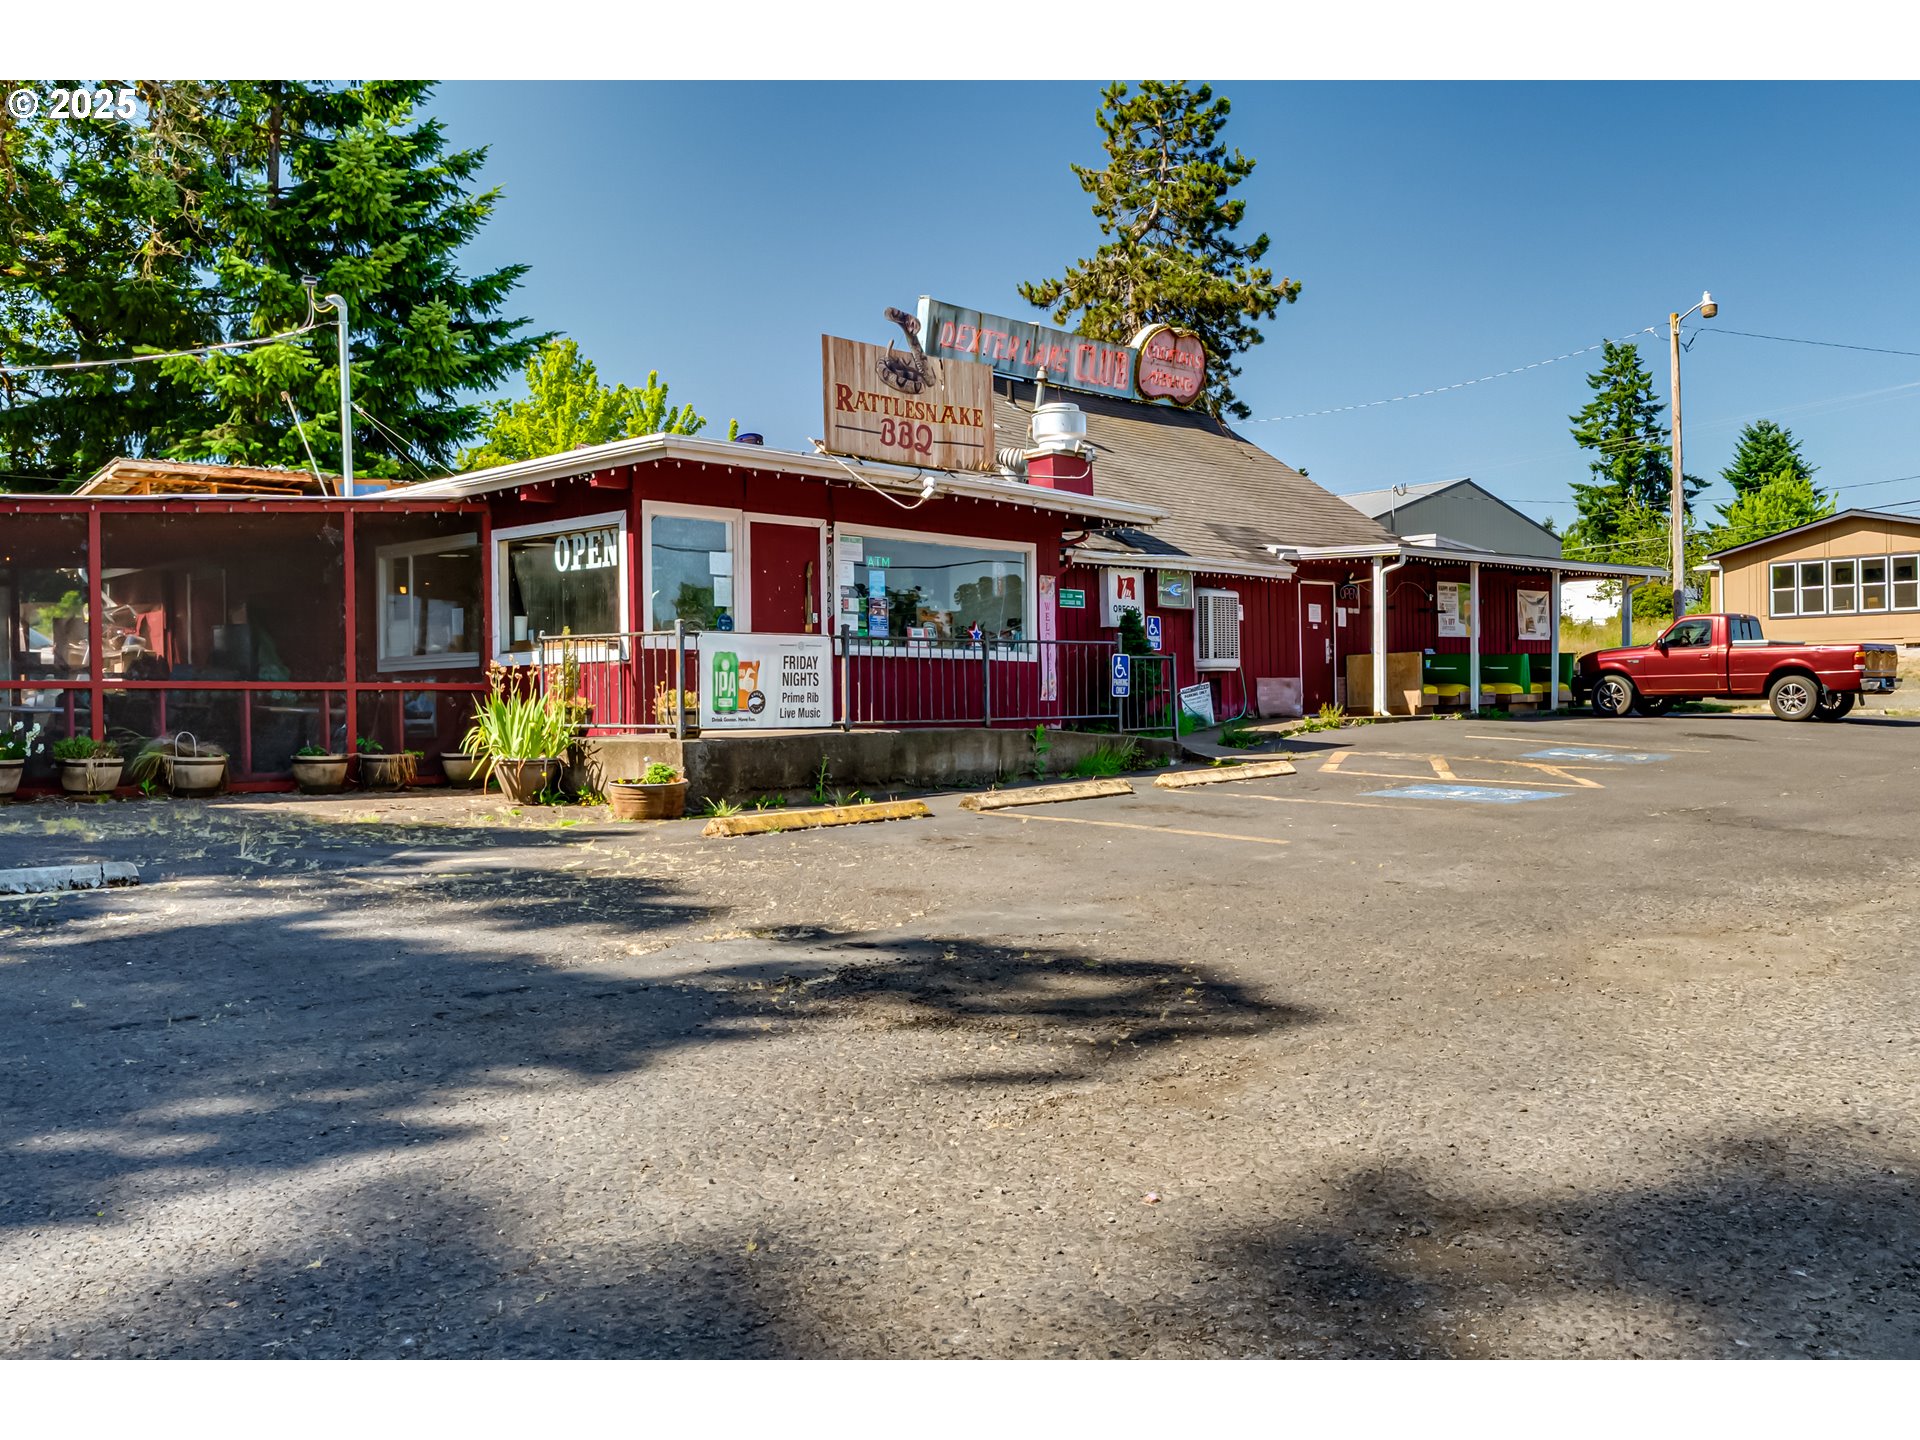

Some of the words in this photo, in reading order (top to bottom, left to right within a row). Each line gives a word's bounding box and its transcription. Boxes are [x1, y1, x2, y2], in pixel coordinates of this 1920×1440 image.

[939, 321, 1020, 362] DEXTER
[1022, 338, 1070, 372] LAKE
[1074, 342, 1129, 390] CLUB
[835, 383, 984, 427] RATTLESNAKE
[880, 418, 933, 455] BBQ
[554, 528, 618, 572] OPEN
[867, 555, 890, 568] ATM
[1113, 604, 1140, 613] OREGON
[783, 655, 819, 670] FRIDAY
[714, 671, 736, 697] IPA
[782, 672, 819, 687] NIGHTS
[782, 692, 805, 703] Prime
[806, 692, 819, 703] Rib
[1115, 686, 1126, 694] ONLY
[779, 707, 796, 719] Live
[797, 707, 821, 719] Music
